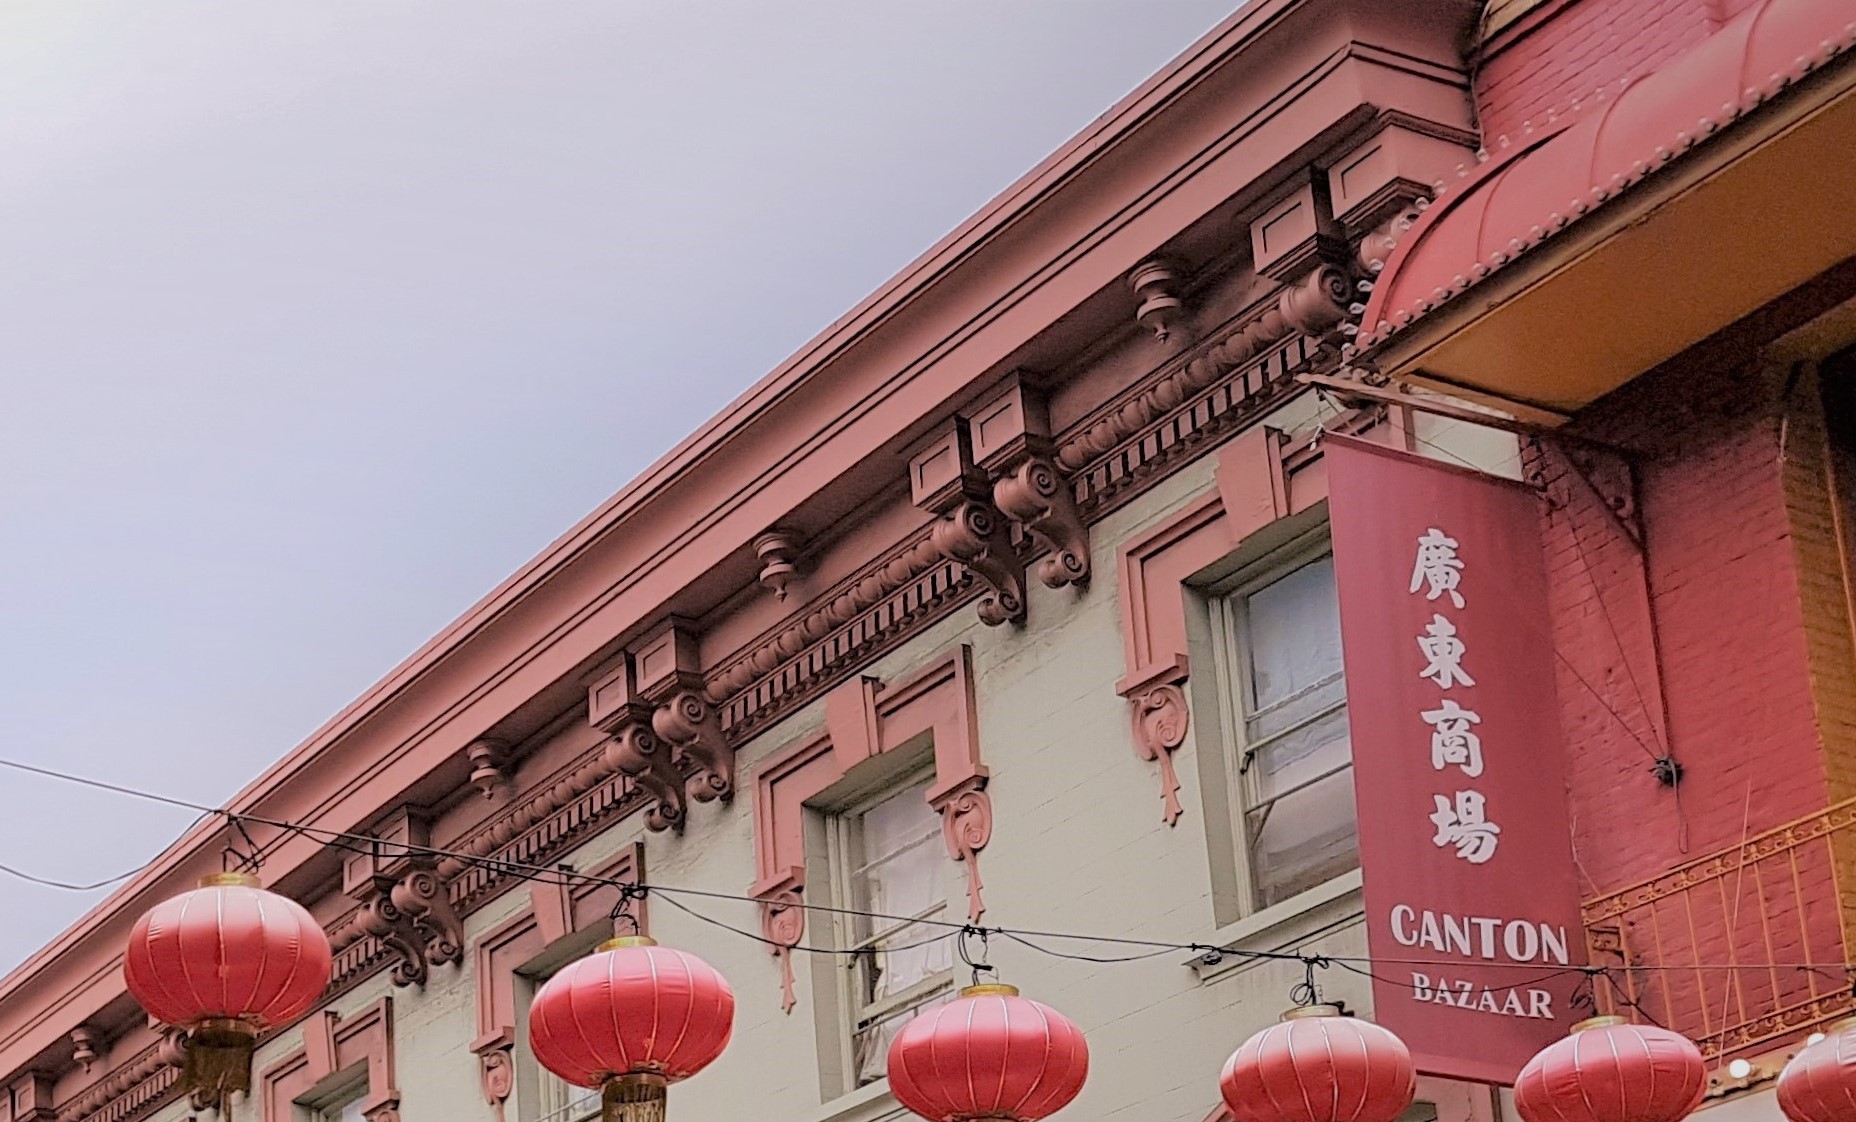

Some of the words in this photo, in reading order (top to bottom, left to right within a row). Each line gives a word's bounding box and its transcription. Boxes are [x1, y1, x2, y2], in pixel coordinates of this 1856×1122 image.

[1409, 527, 1501, 864] 廣東商場
[1389, 903, 1569, 967] CANTON
[1409, 971, 1555, 1021] BAZAAR
